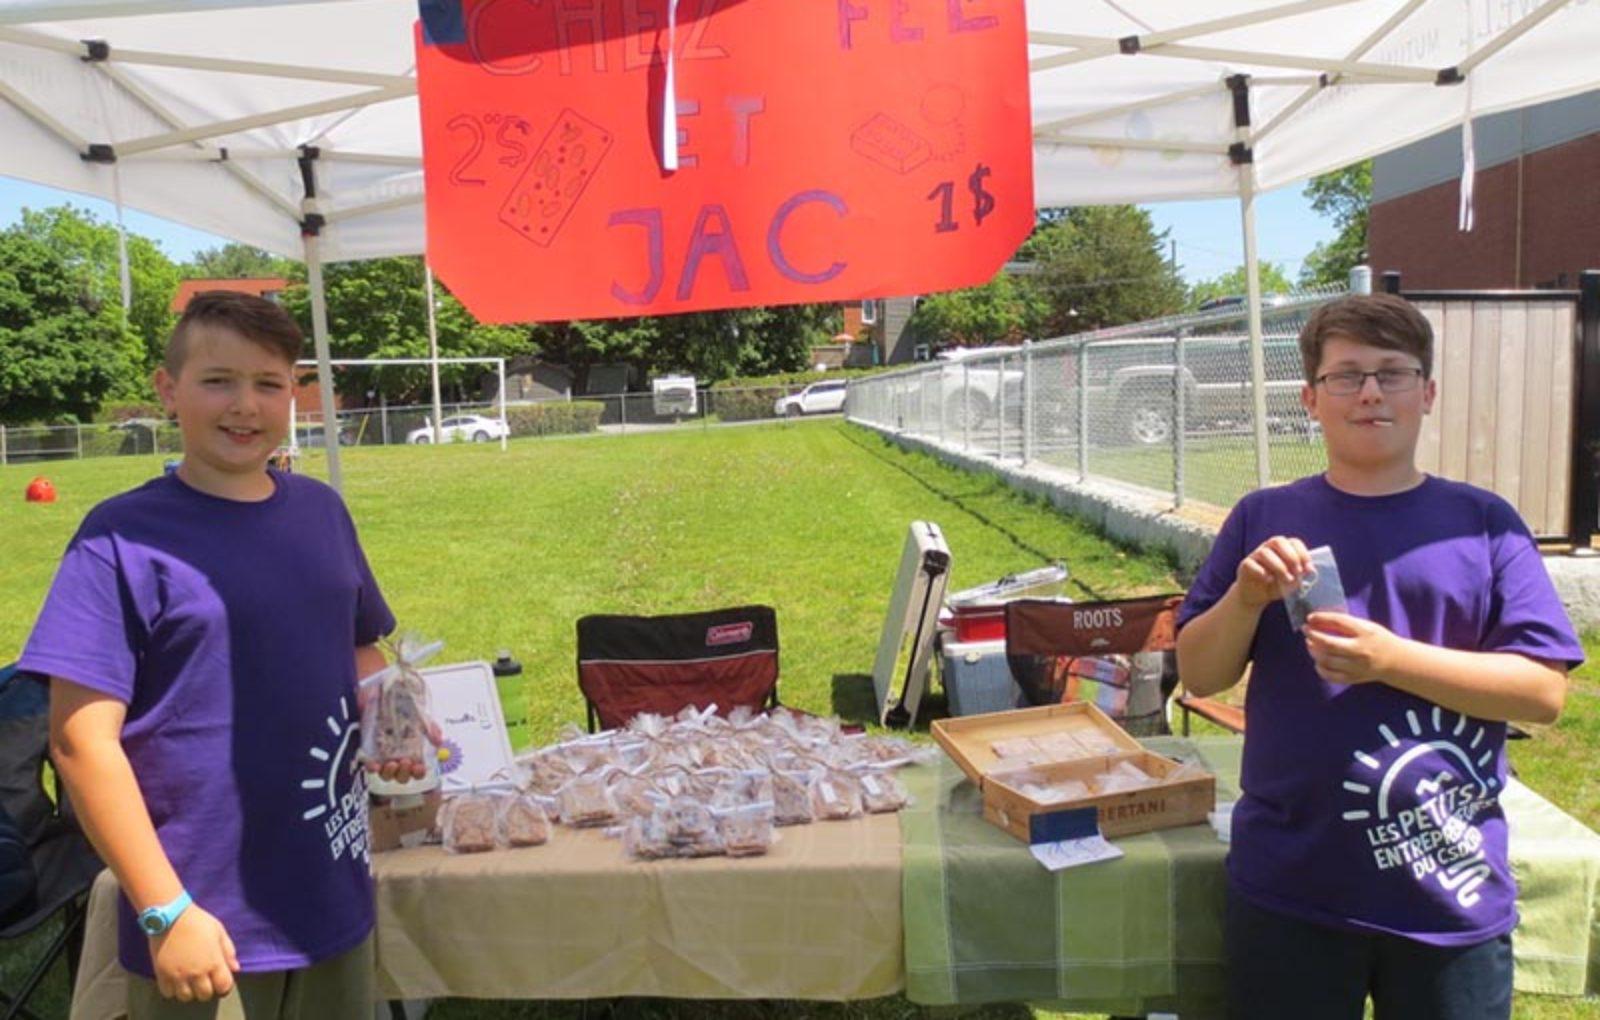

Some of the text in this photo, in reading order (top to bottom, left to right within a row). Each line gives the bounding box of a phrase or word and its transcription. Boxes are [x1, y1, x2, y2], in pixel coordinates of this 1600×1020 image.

[469, 0, 730, 76] CHEZ
[927, 163, 996, 233] 1$
[607, 189, 848, 305] JAC
[1073, 607, 1124, 630] ROOTS
[1366, 783, 1475, 846] LES PETITS
[1412, 854, 1437, 879] DU
